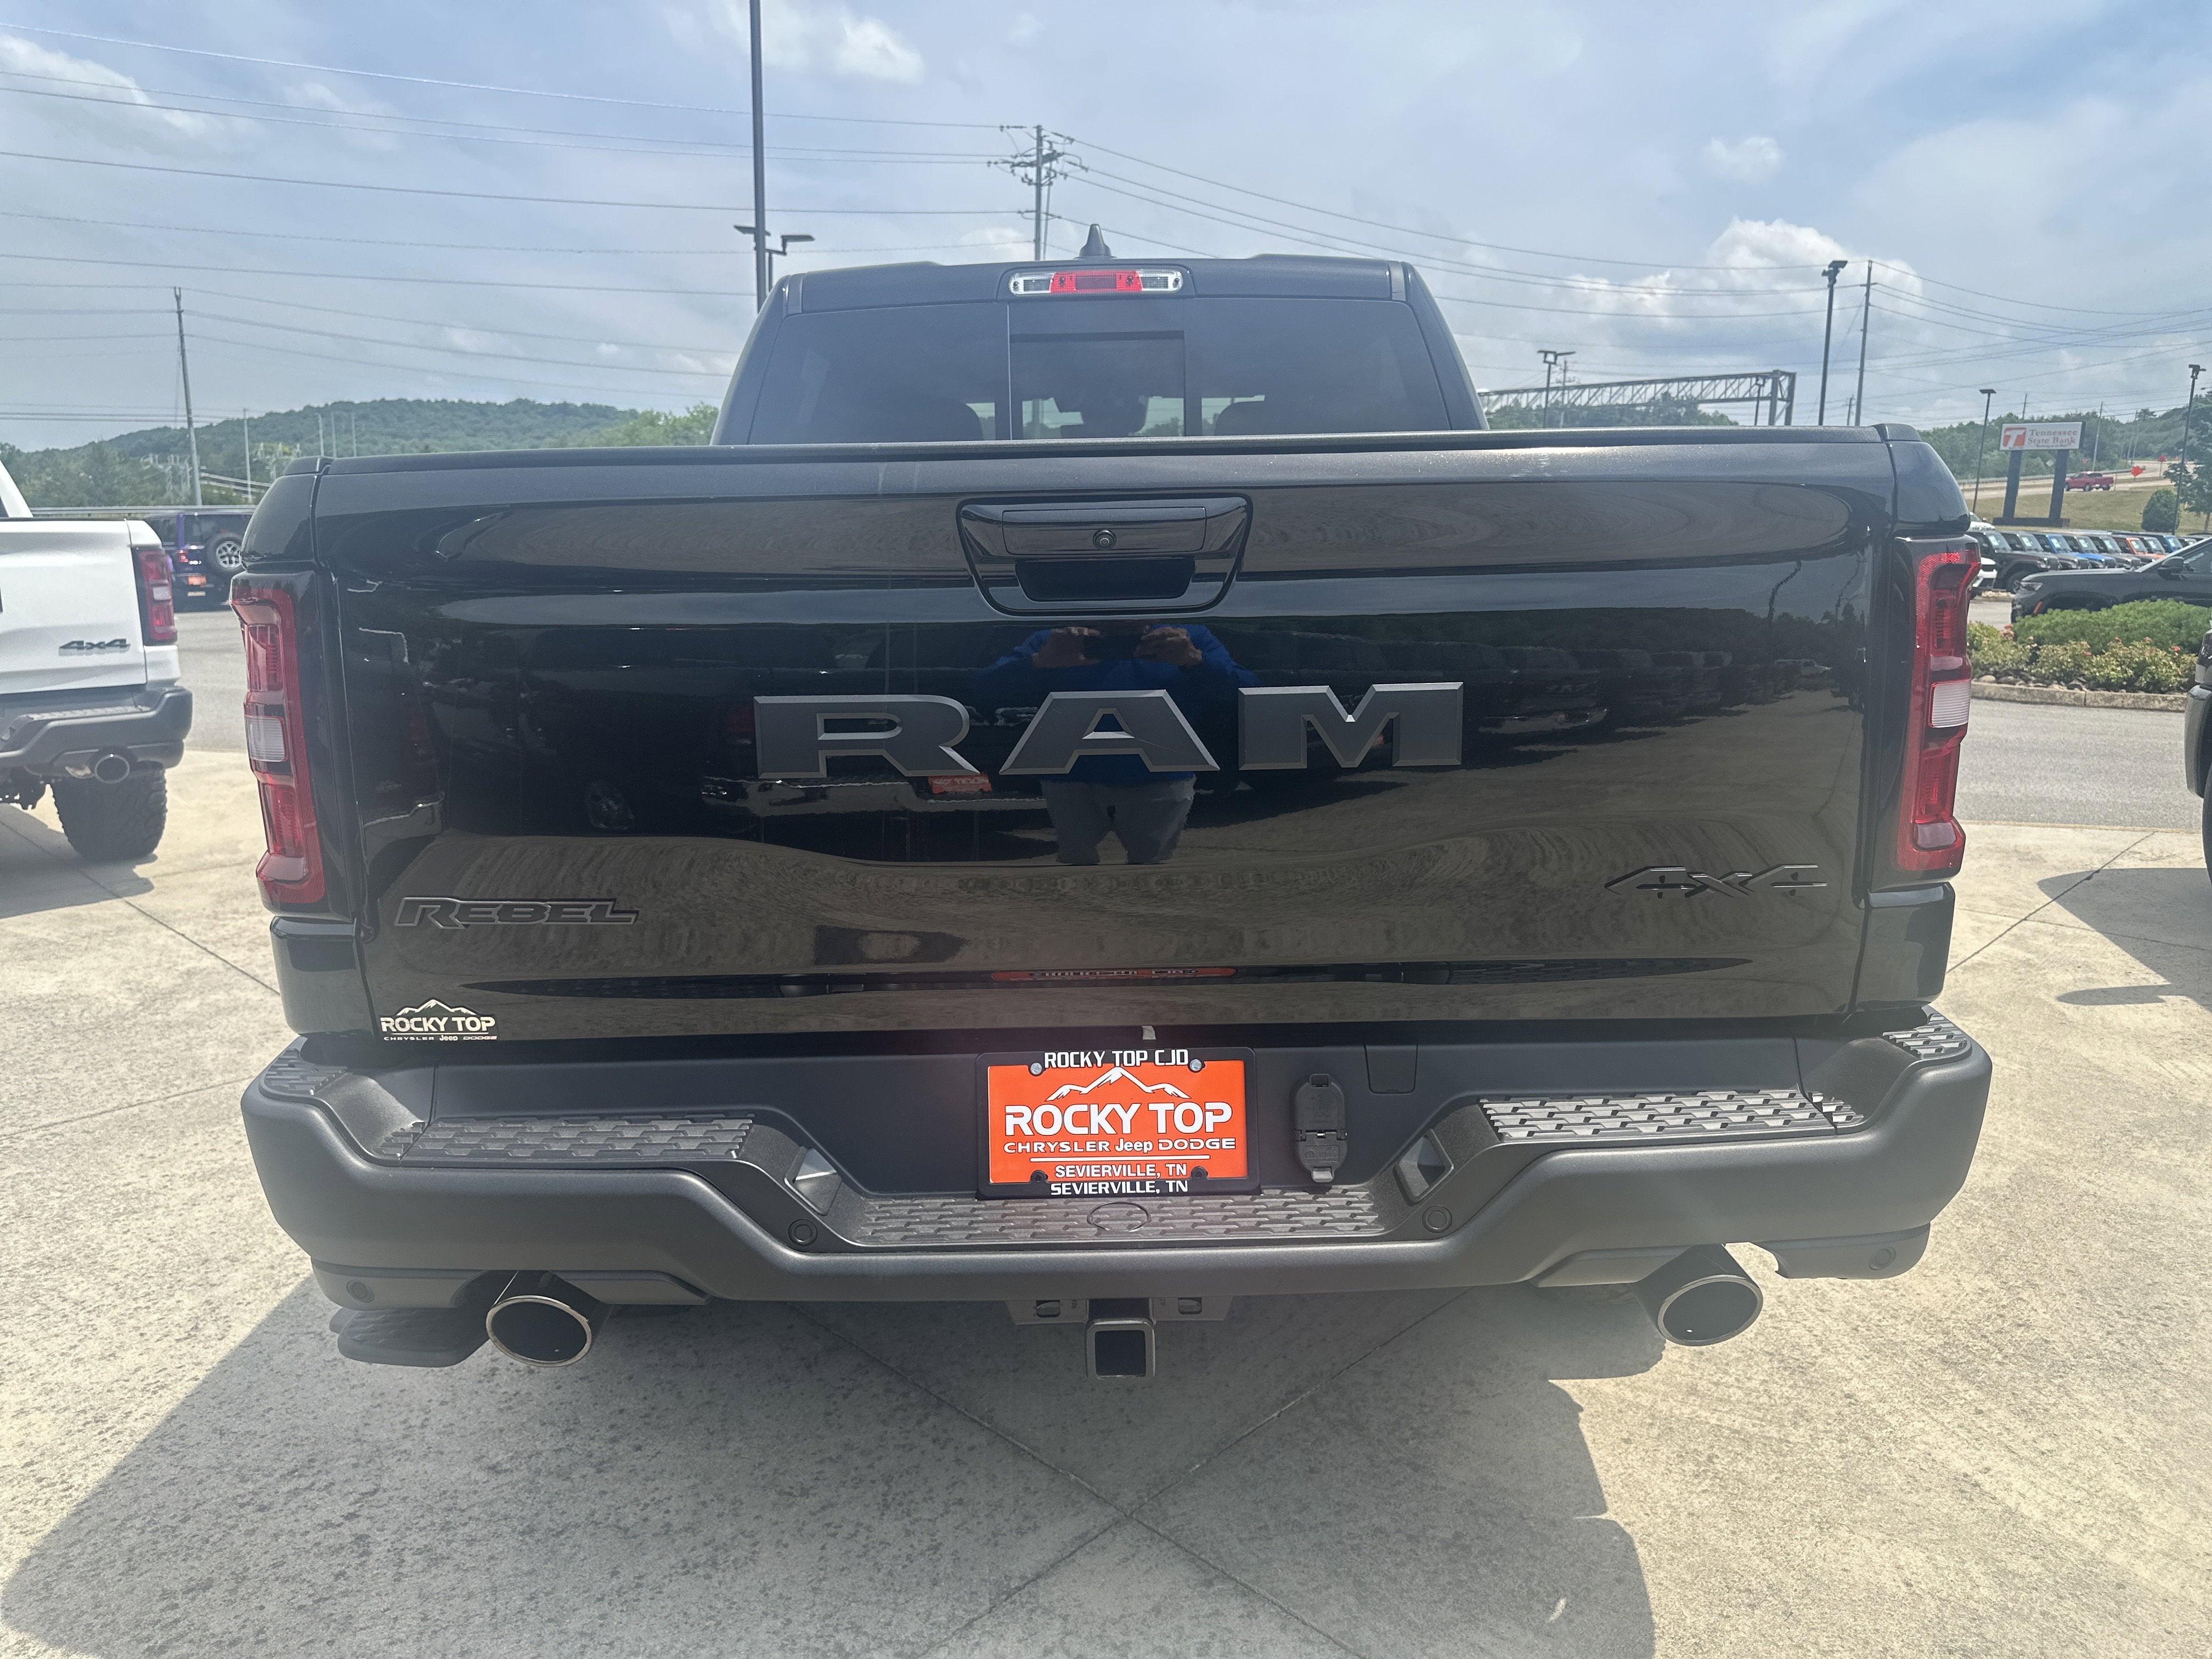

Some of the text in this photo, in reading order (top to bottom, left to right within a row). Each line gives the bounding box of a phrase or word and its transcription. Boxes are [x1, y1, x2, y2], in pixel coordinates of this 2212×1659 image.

[2028, 428, 2078, 437] Tennessee
[2052, 436, 2076, 446] Bank
[754, 682, 1464, 778] RAM
[394, 896, 640, 929] REBEL
[380, 1016, 496, 1032] ROCKY TOP
[1044, 1049, 1189, 1069] ROCKY TOP CJD
[1005, 1102, 1233, 1137] ROCKY TOP
[1003, 1138, 1237, 1154] CHRYSLER Jeep DODGE
[1054, 1164, 1187, 1180] SEVIERVILLE, TN
[1051, 1180, 1188, 1195] SEVIERVILLE, TN
